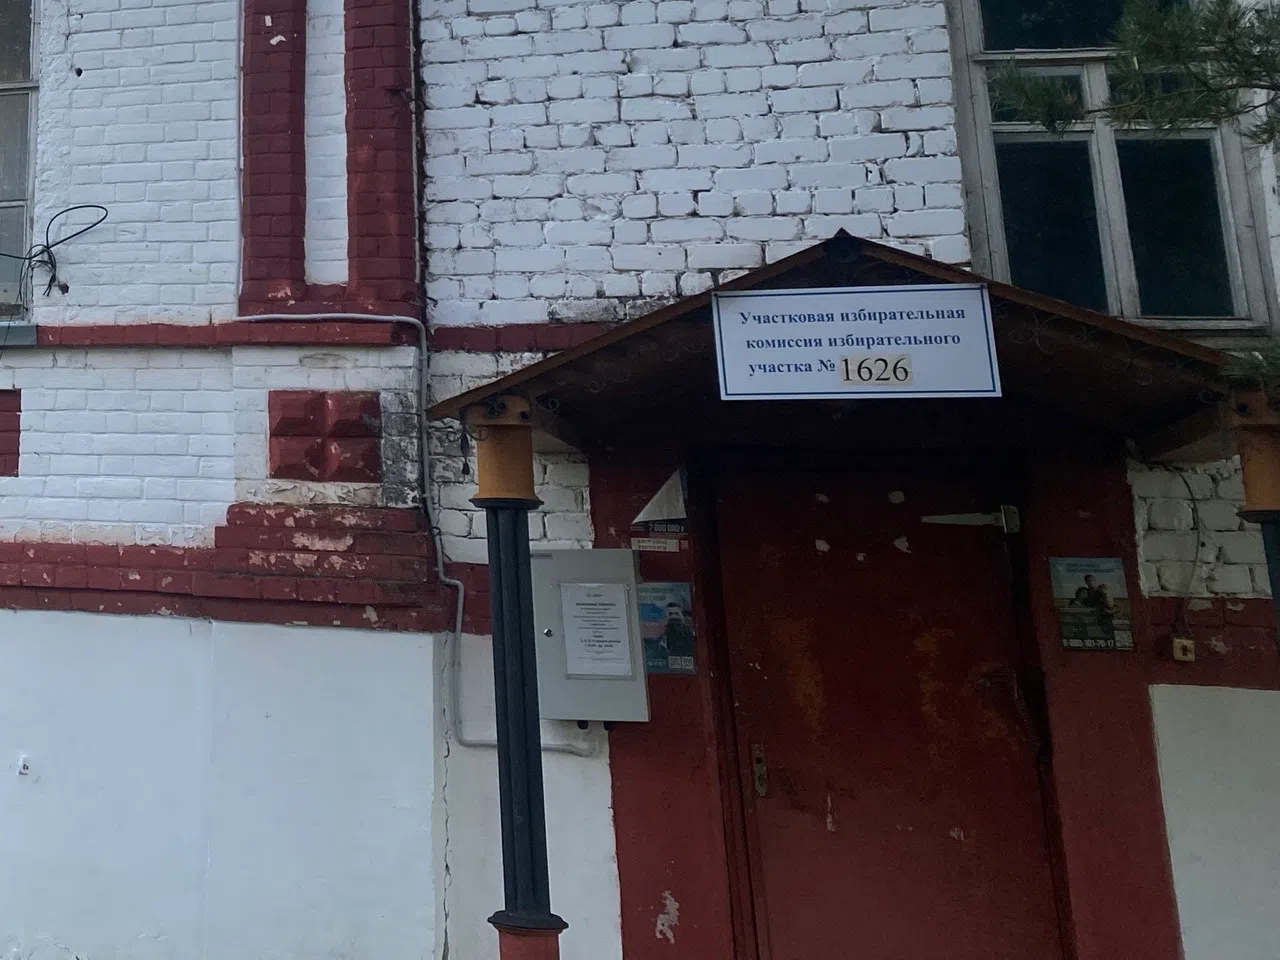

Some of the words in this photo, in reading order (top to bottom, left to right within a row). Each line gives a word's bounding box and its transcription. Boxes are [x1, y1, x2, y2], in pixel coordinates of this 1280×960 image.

[739, 310, 835, 324] Участковая
[840, 307, 966, 323] избирательная
[746, 336, 823, 350] комиссия
[828, 333, 961, 349] избирательного
[748, 361, 813, 376] участка
[817, 358, 836, 373] №
[841, 357, 910, 382] 1626
